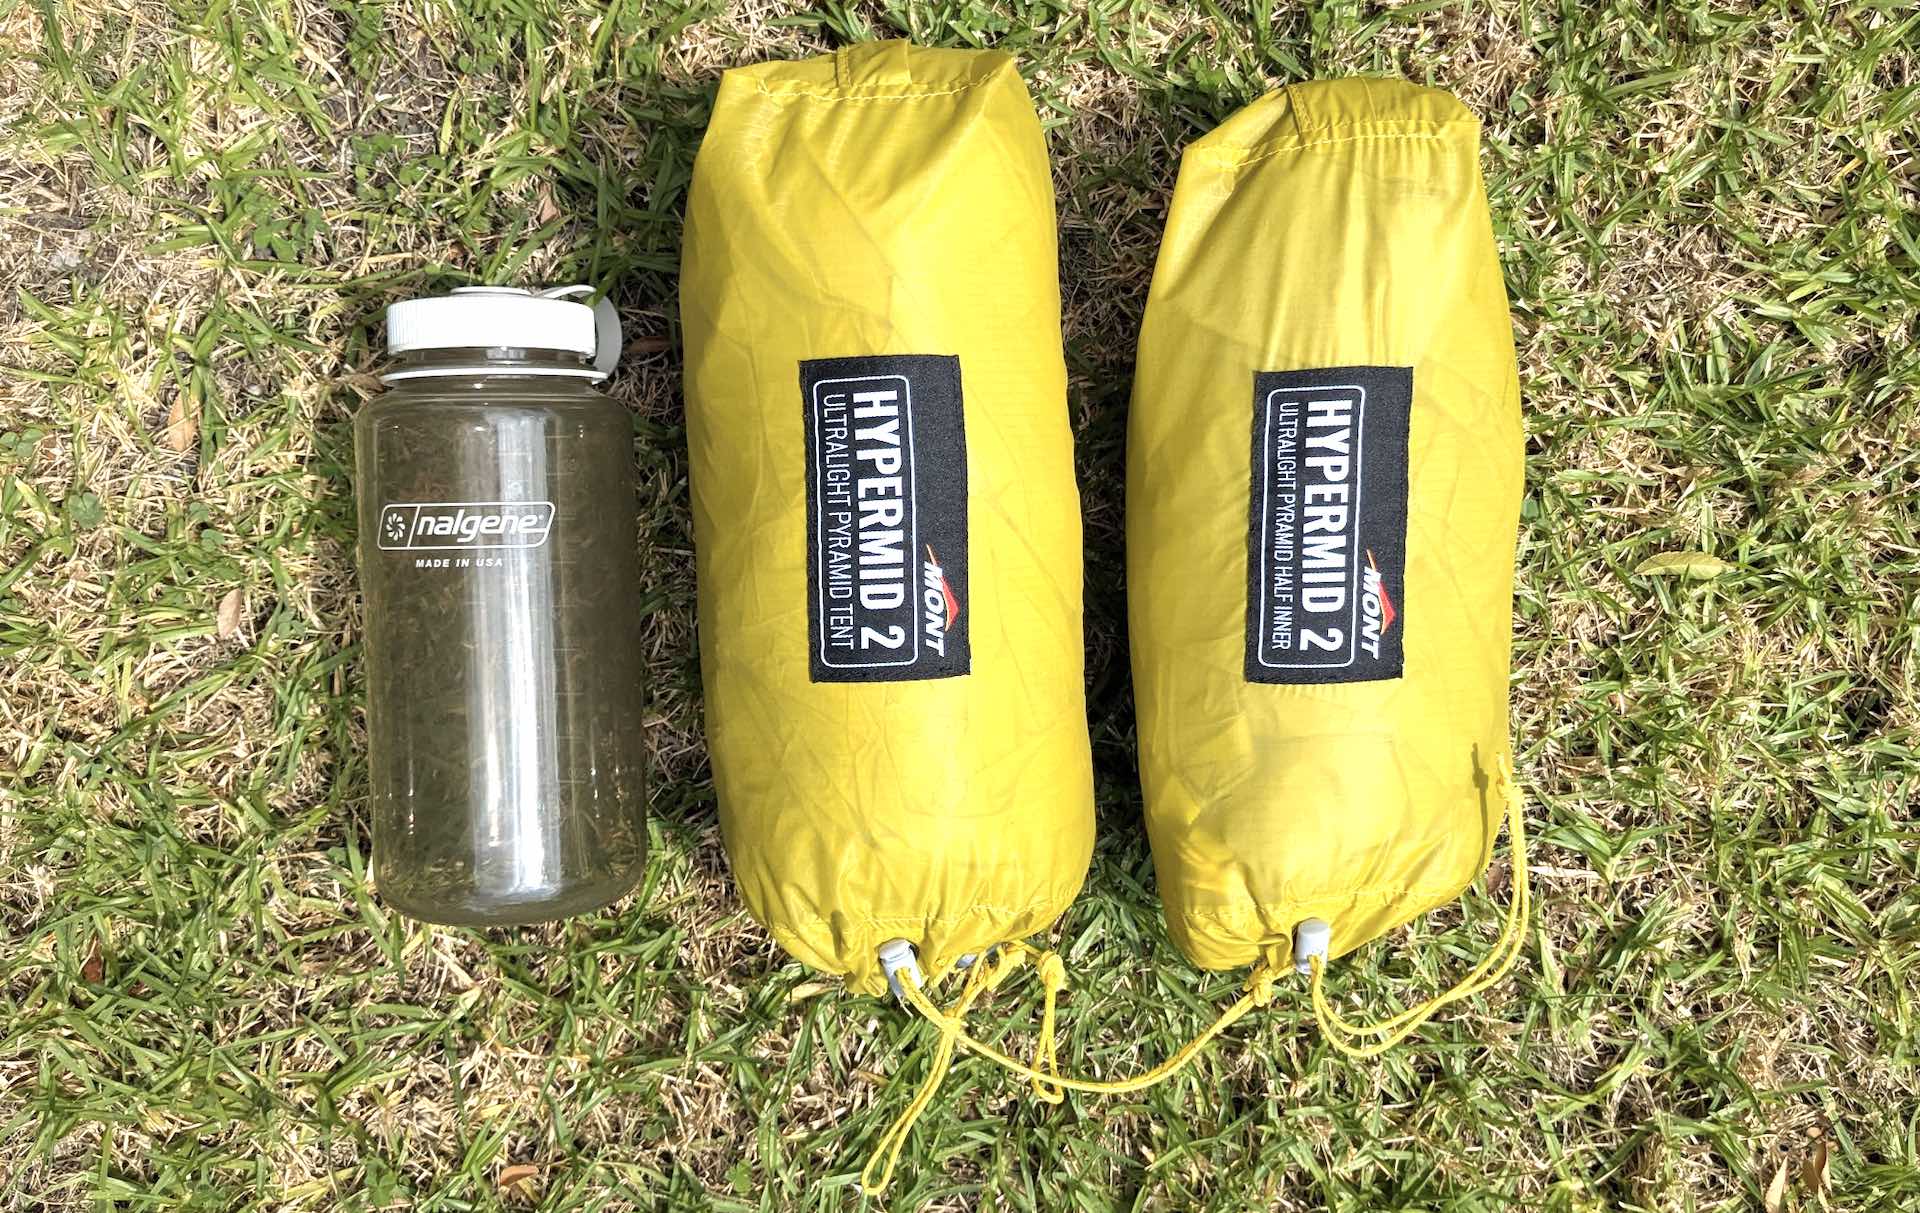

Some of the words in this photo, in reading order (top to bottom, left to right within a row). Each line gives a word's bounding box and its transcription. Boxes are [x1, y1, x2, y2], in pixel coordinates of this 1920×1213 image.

[823, 393, 851, 506] ULTRALIGHT
[1276, 402, 1299, 491] ULTRALIGHT
[416, 509, 547, 543] nalgene
[853, 390, 905, 610] HYPERMID
[1274, 493, 1297, 562] PYRAMID
[1301, 399, 1353, 613] HYPERMID
[415, 559, 450, 568] MADE
[456, 559, 470, 568] IN
[476, 558, 503, 568] USA
[828, 511, 853, 599] PYRAMID
[1273, 566, 1294, 602] HALF
[830, 603, 854, 650] TENT
[860, 625, 905, 650] 2
[924, 561, 945, 657] MONT
[1271, 606, 1293, 650] INNER
[1299, 627, 1344, 652] 2
[1361, 566, 1382, 660] MONT
